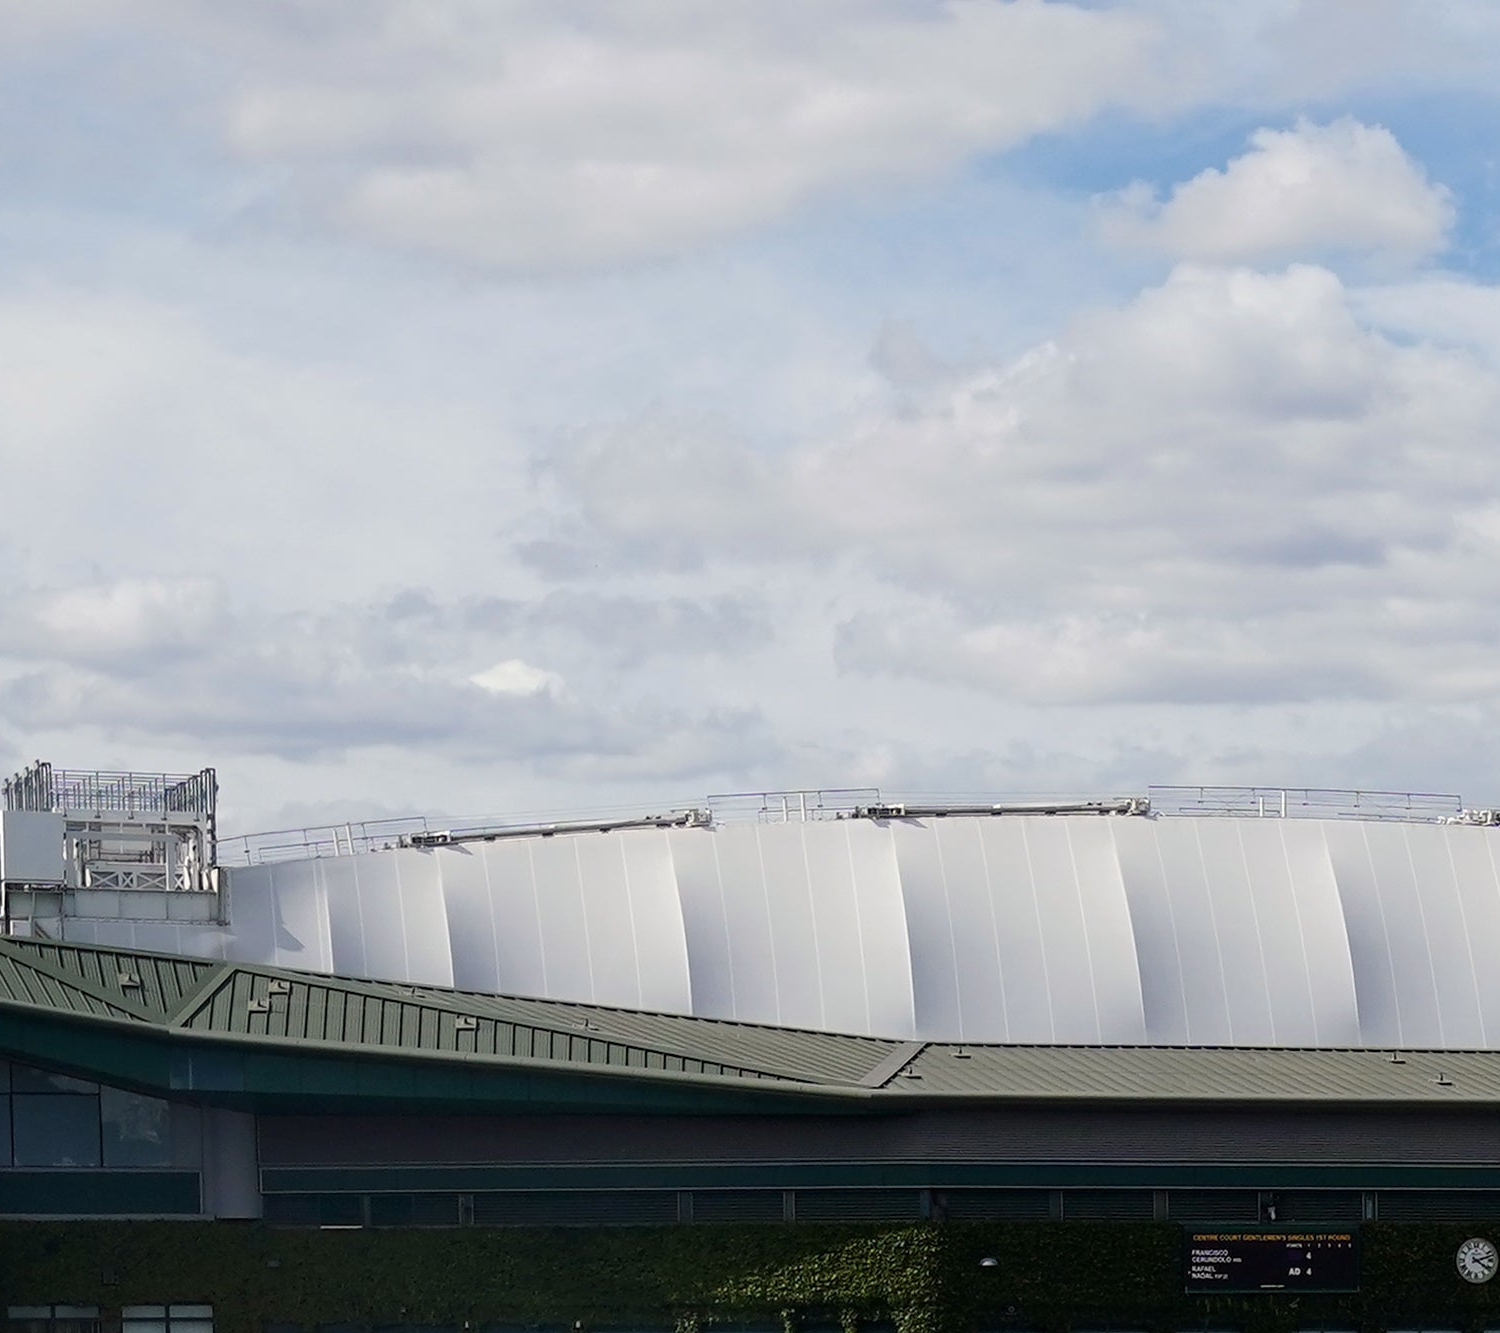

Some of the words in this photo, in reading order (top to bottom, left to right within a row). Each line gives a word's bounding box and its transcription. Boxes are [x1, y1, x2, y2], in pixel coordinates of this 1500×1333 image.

[1192, 1234, 1218, 1242] CENTRE
[1191, 1249, 1228, 1257] FRANCISCO
[1305, 1252, 1312, 1260] 4
[1288, 1267, 1301, 1276] AD
[1306, 1267, 1312, 1276] 4
